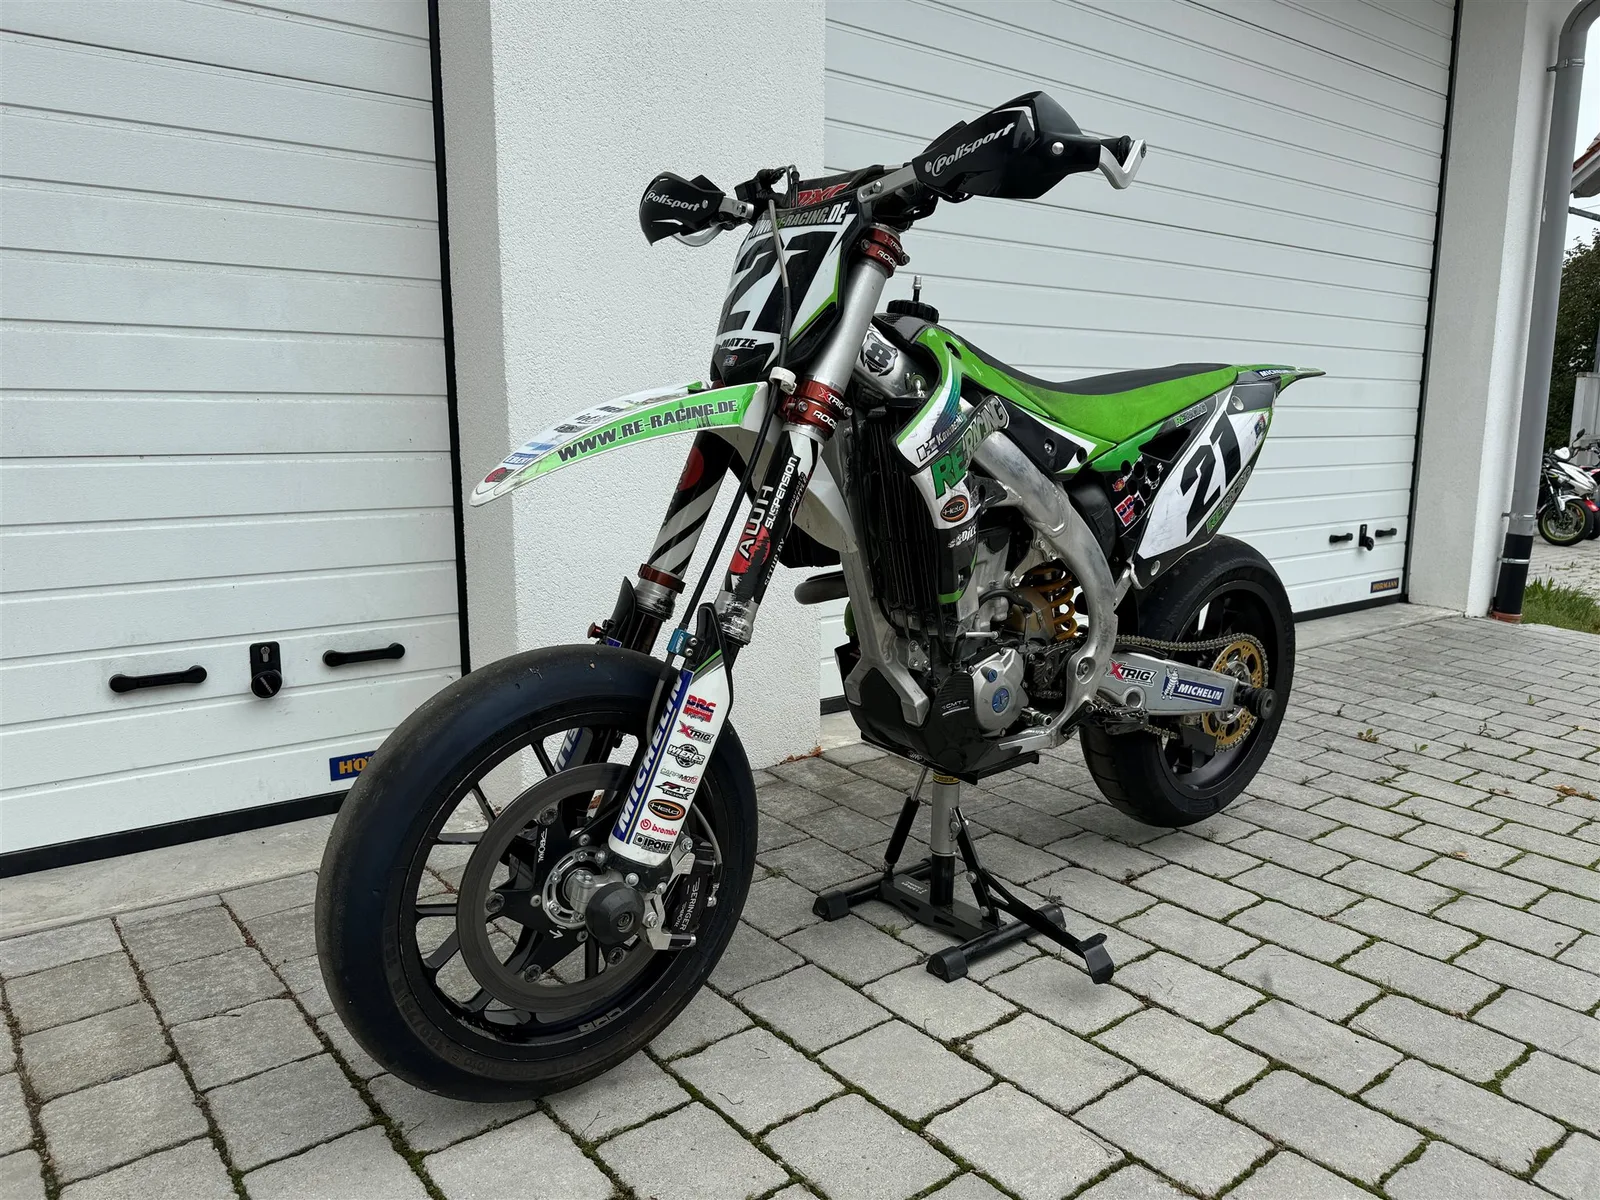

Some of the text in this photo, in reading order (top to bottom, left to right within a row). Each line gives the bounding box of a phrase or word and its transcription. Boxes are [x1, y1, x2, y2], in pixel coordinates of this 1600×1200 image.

[932, 122, 1016, 177] Polisport
[644, 189, 701, 212] Polisport
[720, 337, 758, 349] MATZE
[818, 386, 845, 410] XTRIG
[557, 400, 738, 462] WWW.RE-RACING.DE
[1179, 410, 1242, 538] 21
[765, 456, 798, 529] SUSPENSION
[1109, 661, 1153, 682] XTRIG
[1177, 682, 1223, 701] MICHELIN
[677, 719, 713, 742] XTRIG
[617, 674, 685, 834] MICHELIN
[643, 836, 673, 851] IPONE
[679, 877, 701, 931] BERINGER
